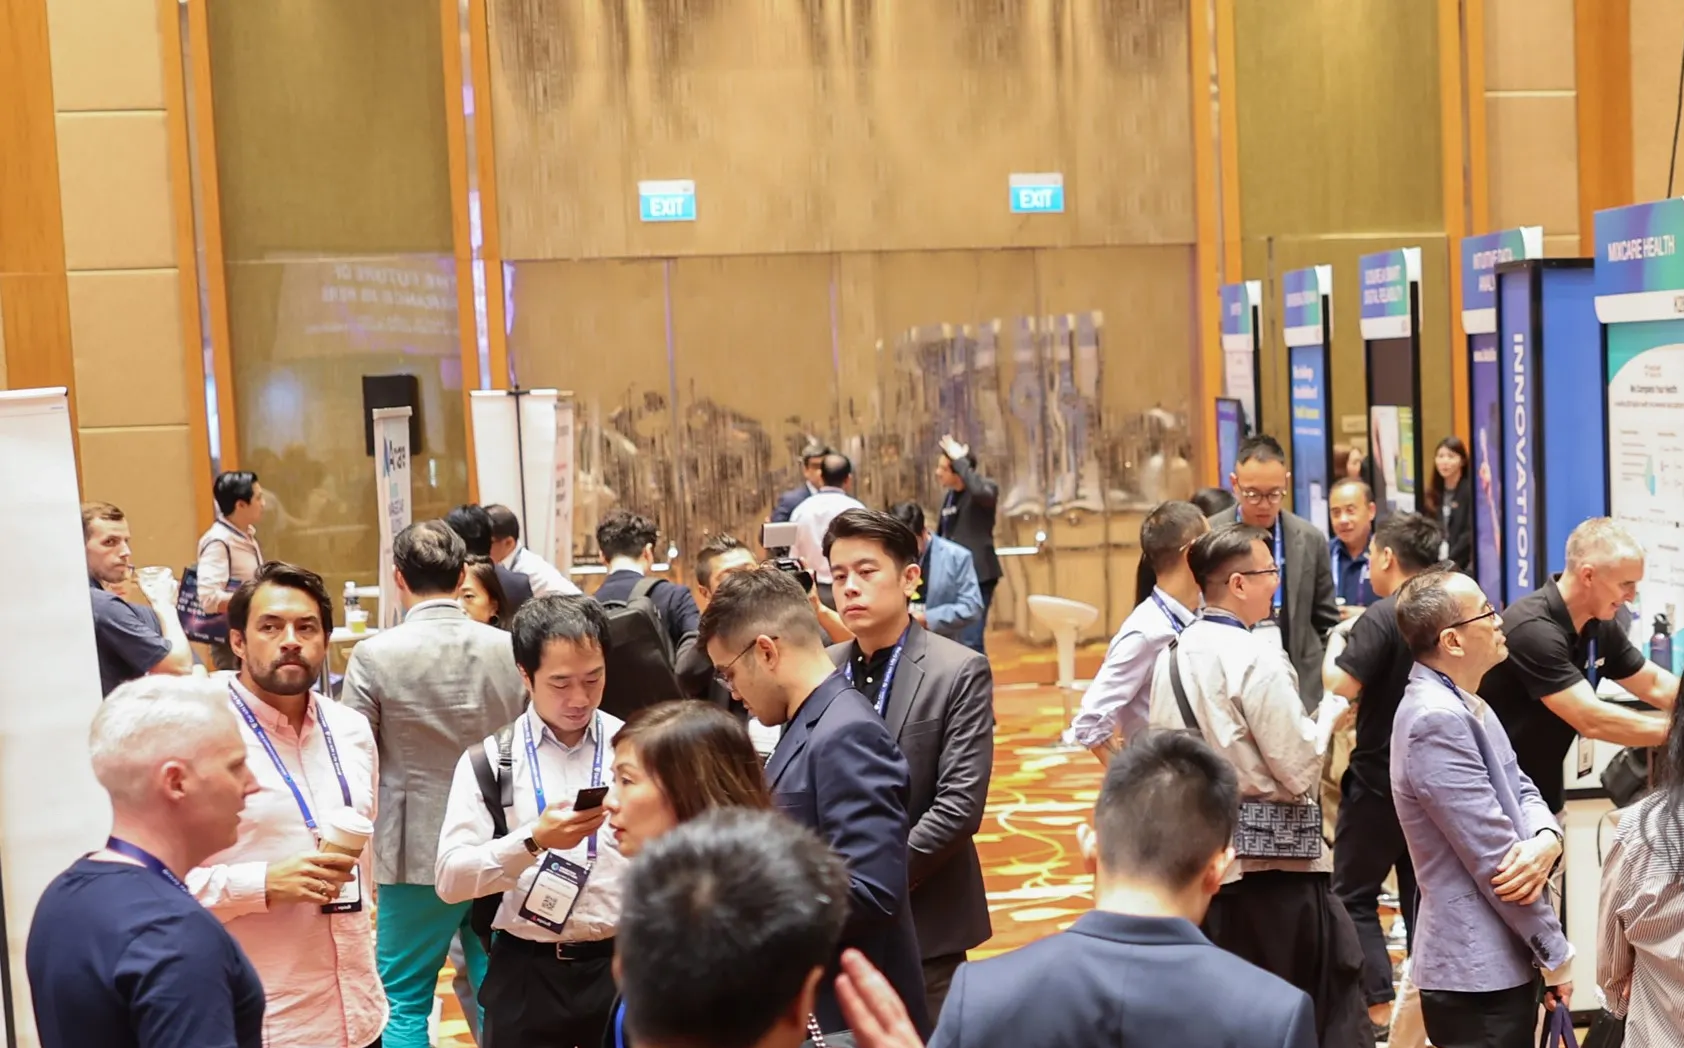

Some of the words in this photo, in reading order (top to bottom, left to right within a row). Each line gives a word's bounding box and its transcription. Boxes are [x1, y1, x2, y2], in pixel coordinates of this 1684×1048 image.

[650, 196, 684, 216] EXIT
[1020, 189, 1052, 208] EXIT
[1608, 239, 1642, 262] MIXCARE
[1643, 234, 1675, 259] HEALTH
[1512, 333, 1529, 588] INNOVATION
